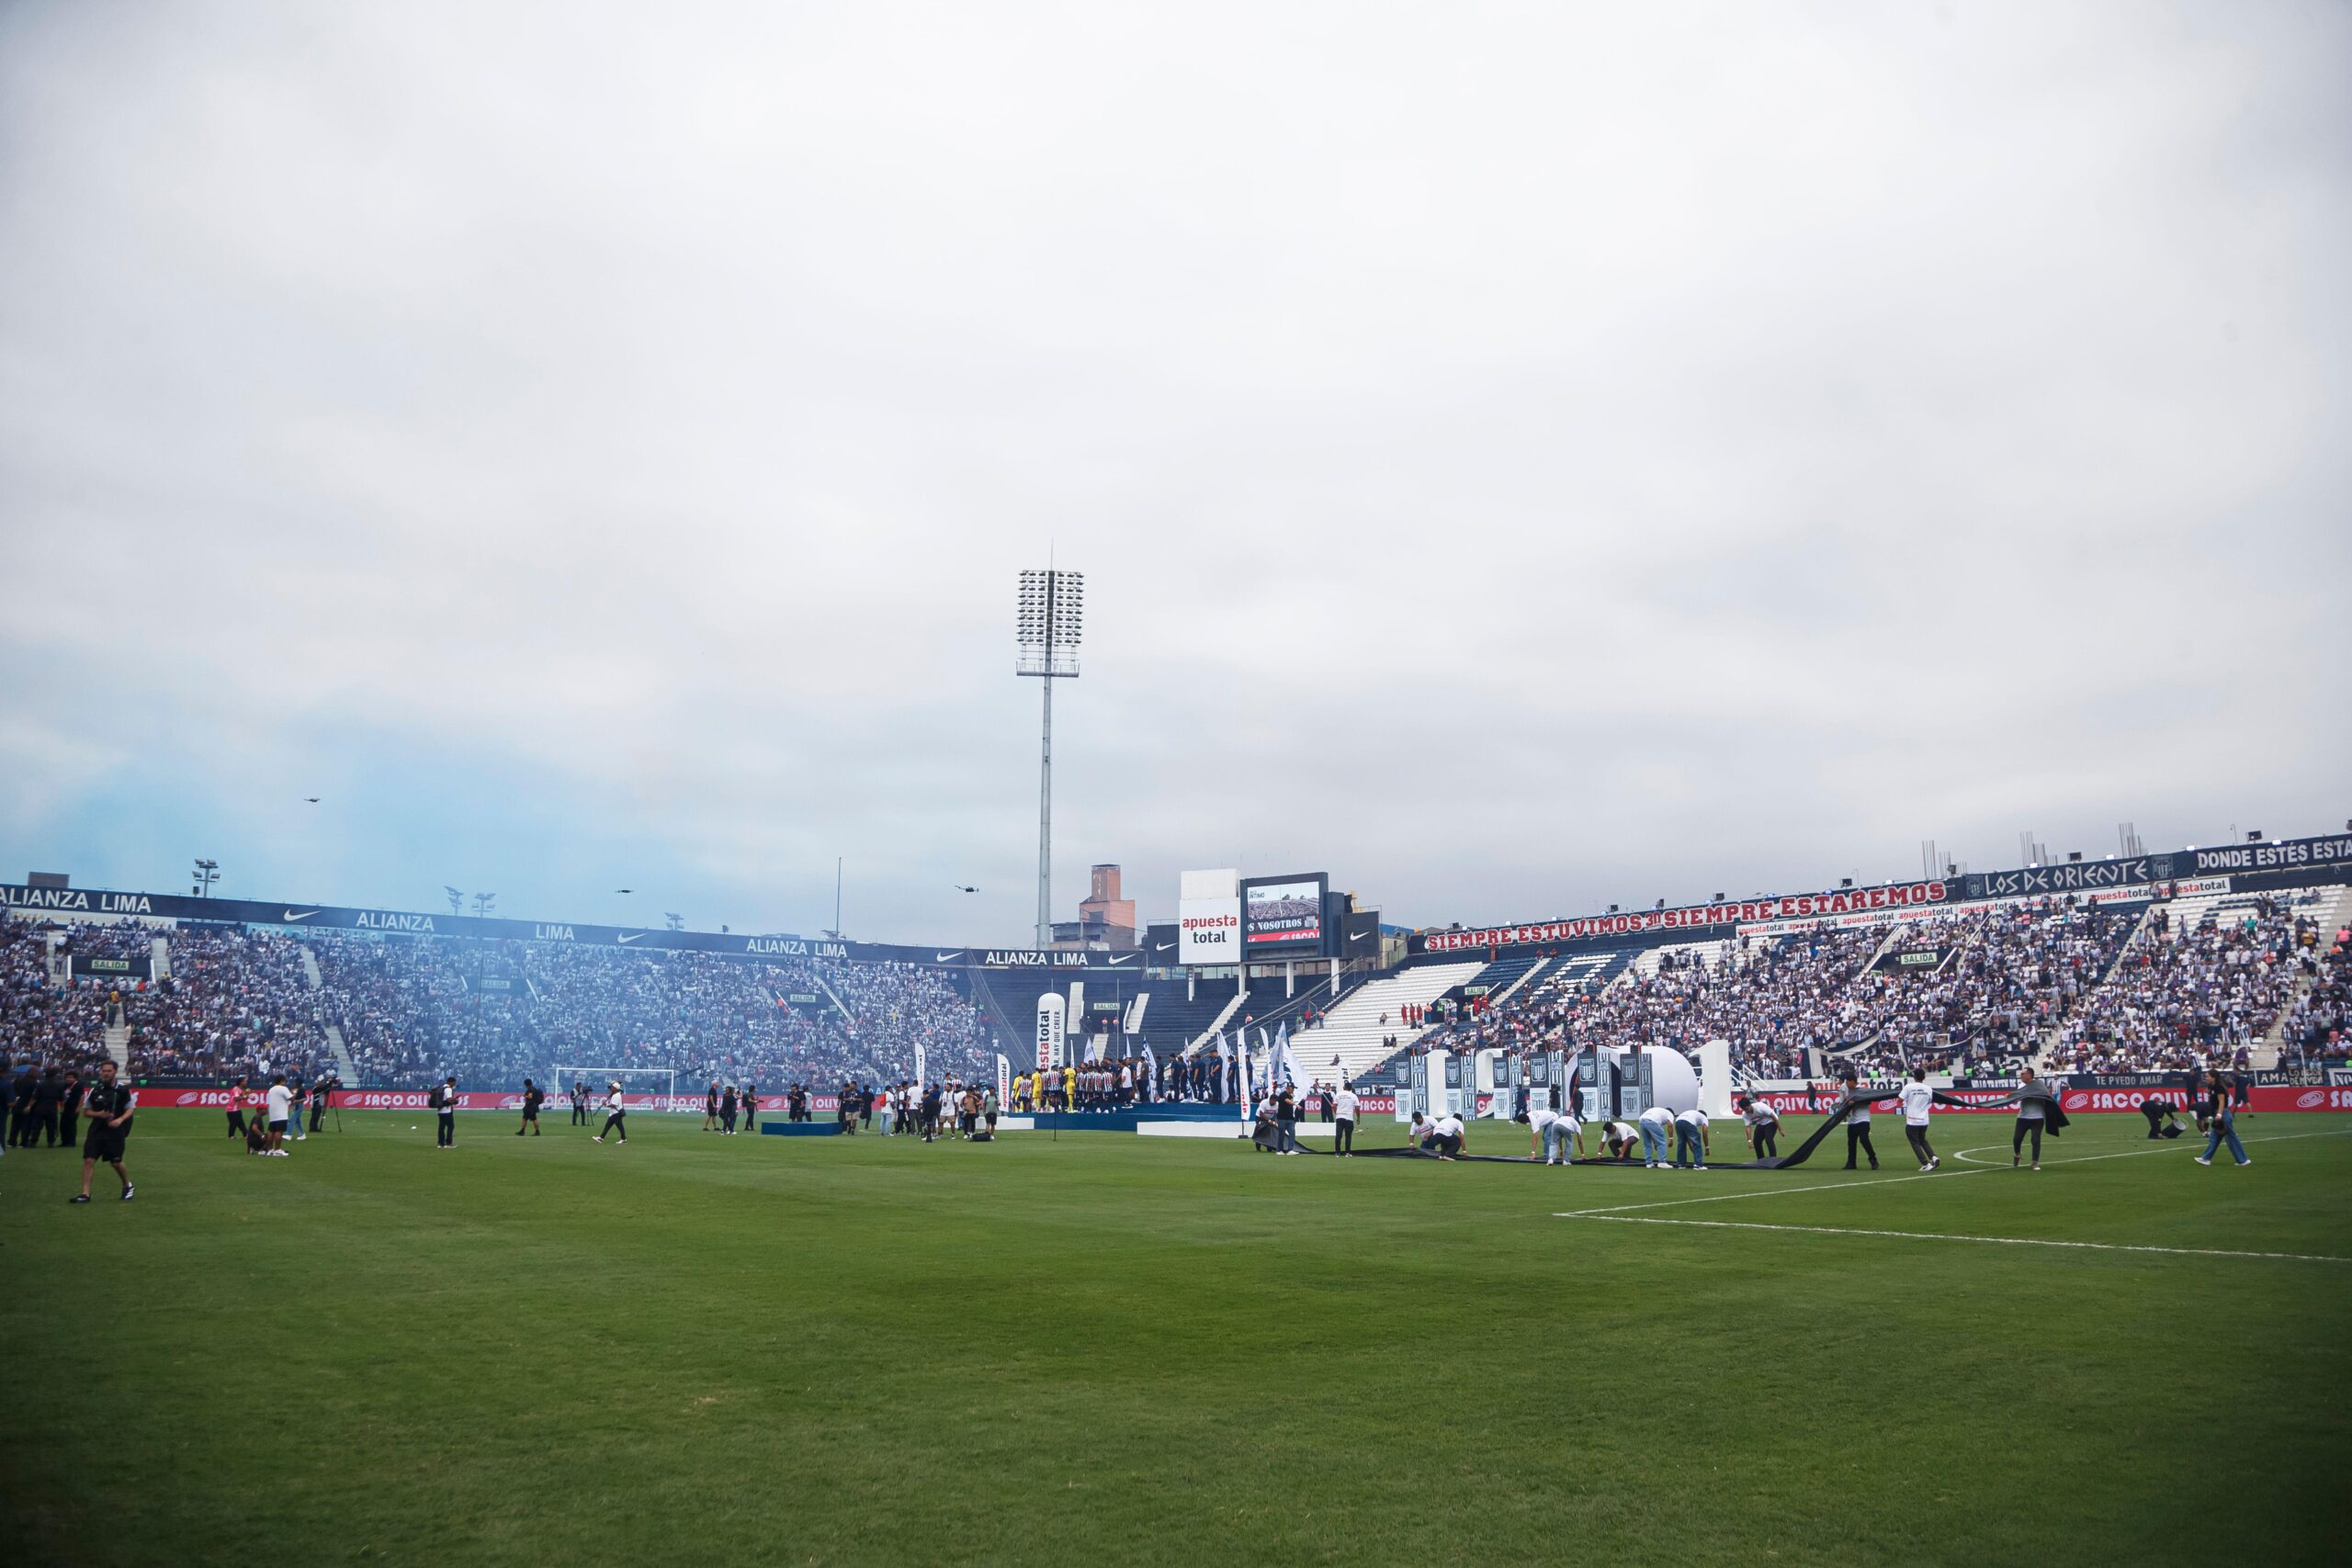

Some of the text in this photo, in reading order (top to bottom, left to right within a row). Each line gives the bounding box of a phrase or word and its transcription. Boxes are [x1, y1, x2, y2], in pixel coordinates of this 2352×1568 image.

[2198, 850, 2251, 869] DONDE
[2256, 841, 2308, 865] ESTÉS
[1984, 861, 2148, 896] LOS DE ORIENTE
[2158, 881, 2226, 897] apestatotal
[101, 894, 152, 913] LIMA
[356, 911, 435, 931] ALIANZA
[1182, 915, 1238, 931] apuesta
[1428, 928, 1512, 951] SIEMPRE
[1517, 914, 1643, 943] ESTUVIMOS
[1663, 902, 1774, 928] SIEMPRE
[1781, 882, 1946, 917] ESTAREMOS
[1843, 907, 1953, 925] apuestatotal apuestatotal
[536, 924, 574, 941] LIMA
[1193, 931, 1227, 943] total
[746, 939, 847, 957] ALIANZA LIMA
[94, 960, 127, 969] SALIDA
[985, 952, 1088, 965] ALIANZA LIMA
[1904, 953, 1934, 964] SALIDA
[1466, 987, 1487, 995] SALIDA
[1039, 1010, 1050, 1071] estatotal
[2096, 1076, 2106, 1086] TE
[2140, 1075, 2163, 1085] AMAR
[200, 1092, 231, 1104] SAC
[365, 1094, 404, 1106] SACO
[2093, 1093, 2145, 1109] SACO
